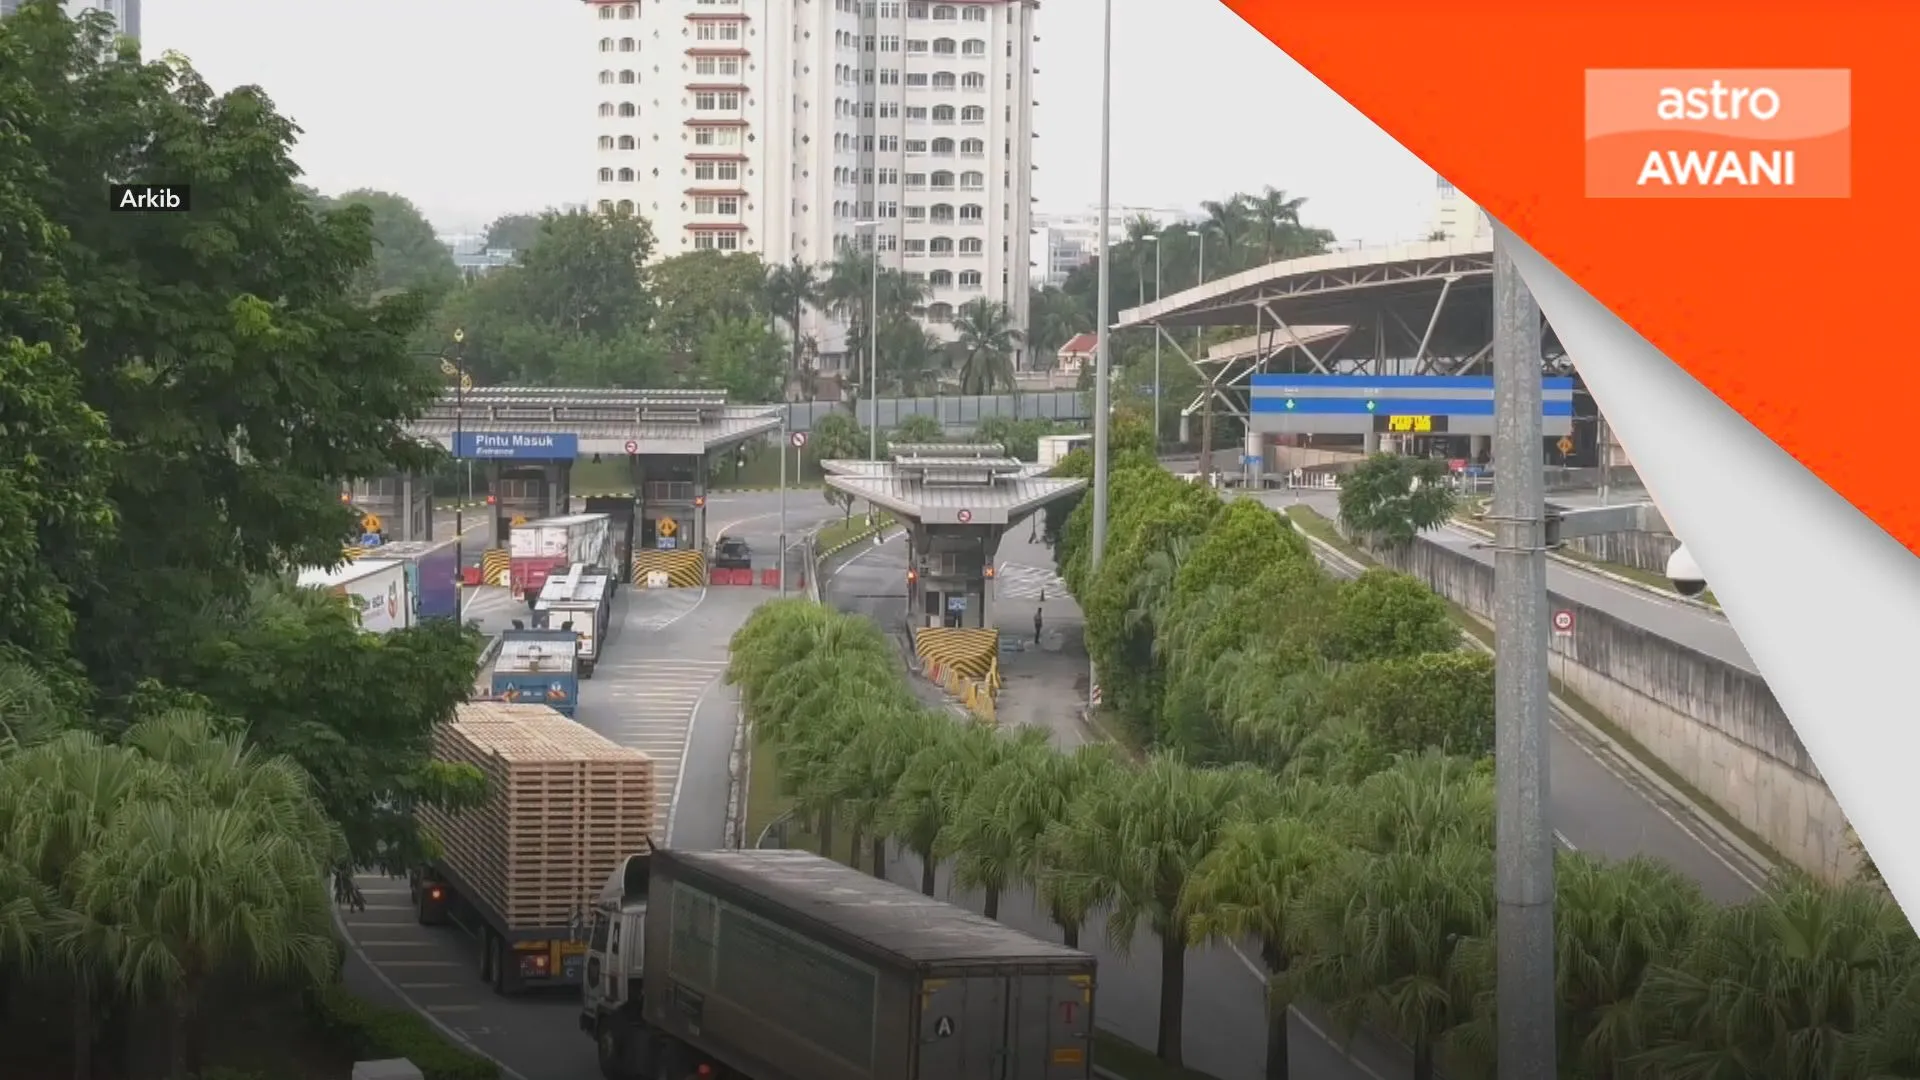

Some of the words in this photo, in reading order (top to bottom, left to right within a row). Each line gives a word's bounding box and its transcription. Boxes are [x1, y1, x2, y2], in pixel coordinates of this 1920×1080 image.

[475, 434, 509, 447] Pintu
[512, 434, 554, 447] Masuk
[937, 1016, 952, 1037] A
